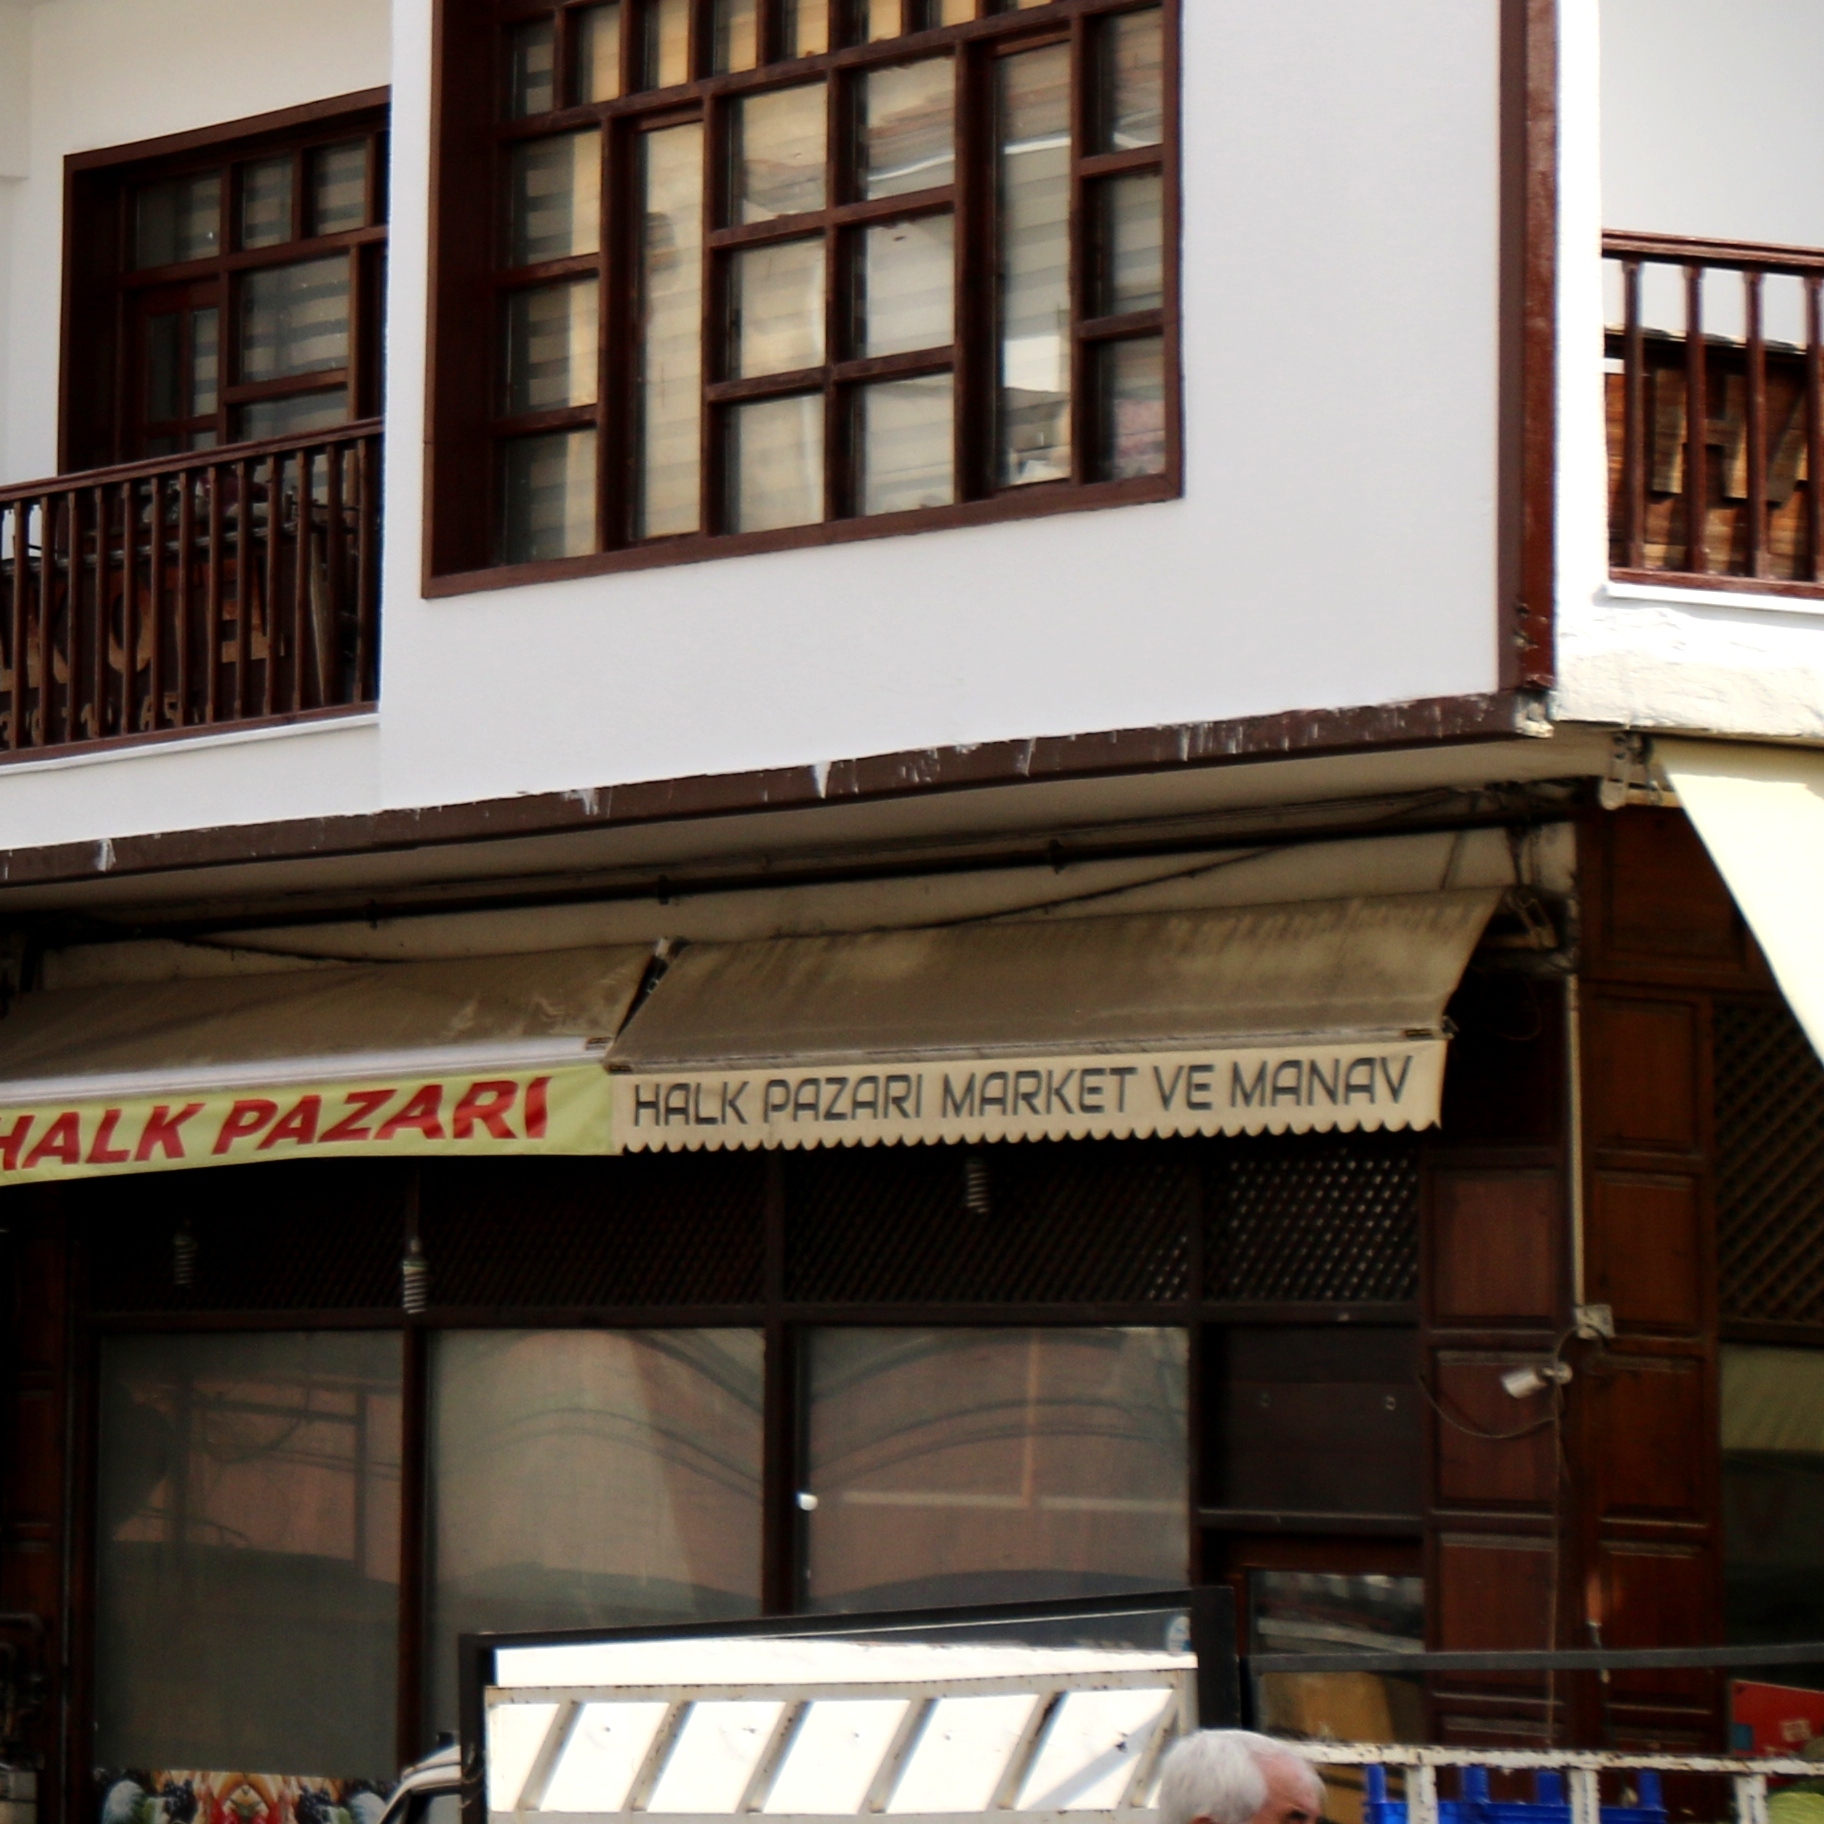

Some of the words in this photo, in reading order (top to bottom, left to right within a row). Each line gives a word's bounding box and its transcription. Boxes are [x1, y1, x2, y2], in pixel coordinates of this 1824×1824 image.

[211, 1076, 552, 1155] PAZARI
[633, 1080, 748, 1127] HALK
[763, 1073, 923, 1123] PAZARI
[943, 1066, 1138, 1118] MARKET
[1152, 1064, 1215, 1111] VE
[1230, 1055, 1414, 1107] MANAV
